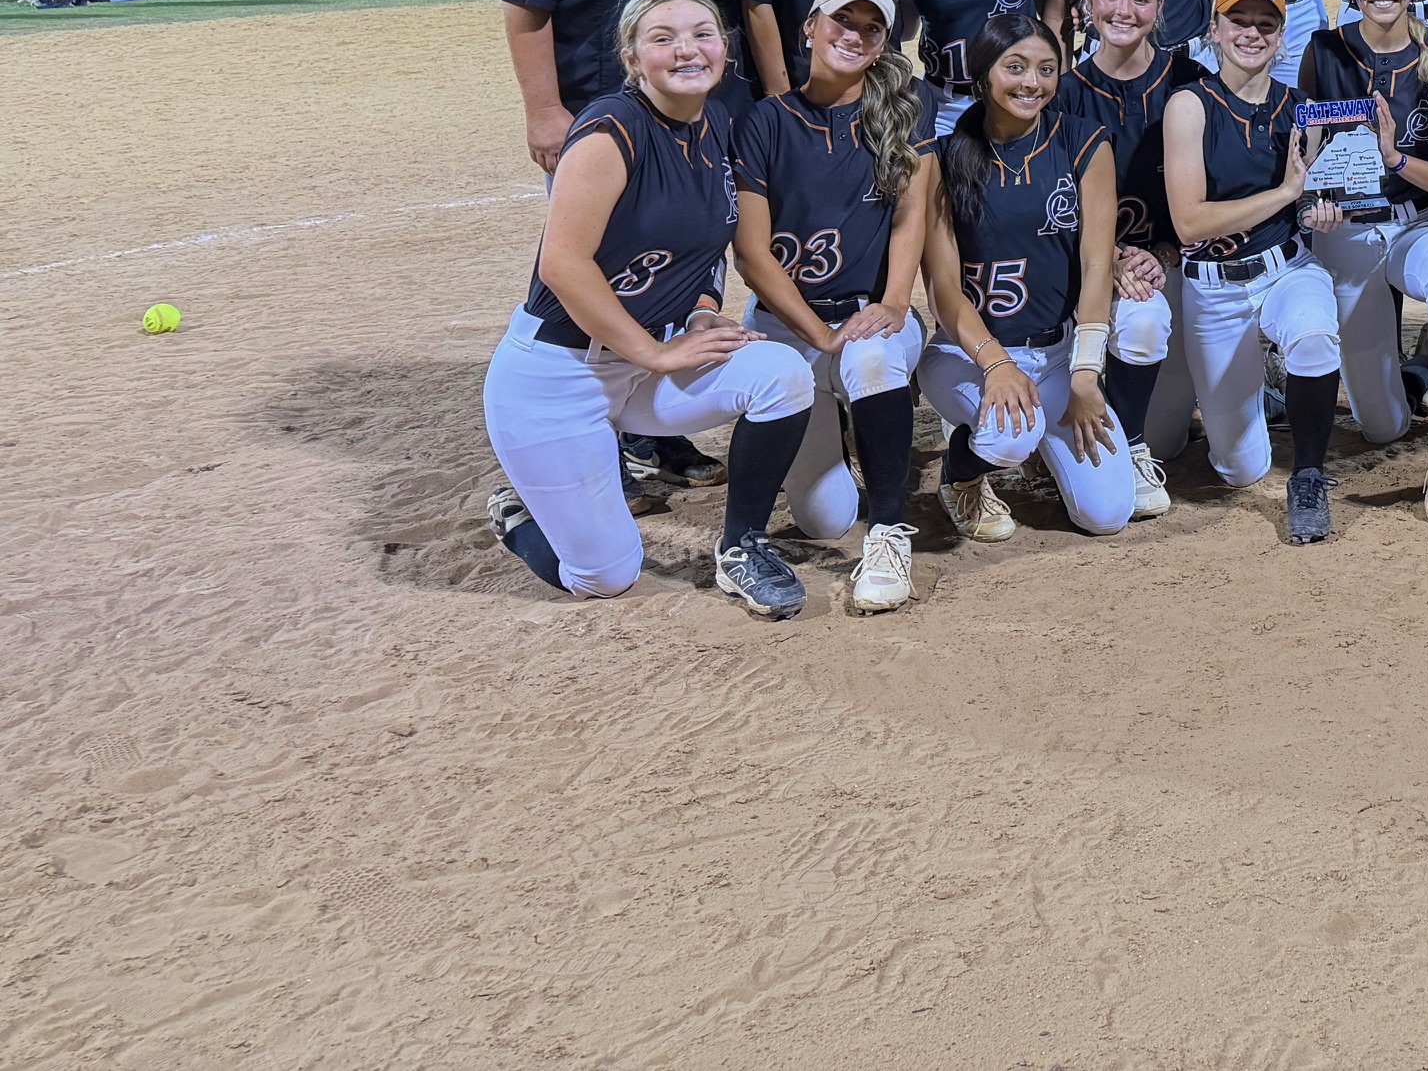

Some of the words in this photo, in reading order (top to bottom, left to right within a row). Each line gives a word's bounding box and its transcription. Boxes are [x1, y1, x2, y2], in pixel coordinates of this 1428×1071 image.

[1296, 98, 1375, 128] GATEWAY
[609, 249, 673, 297] 8
[770, 228, 843, 284] 23
[963, 258, 1029, 318] 55
